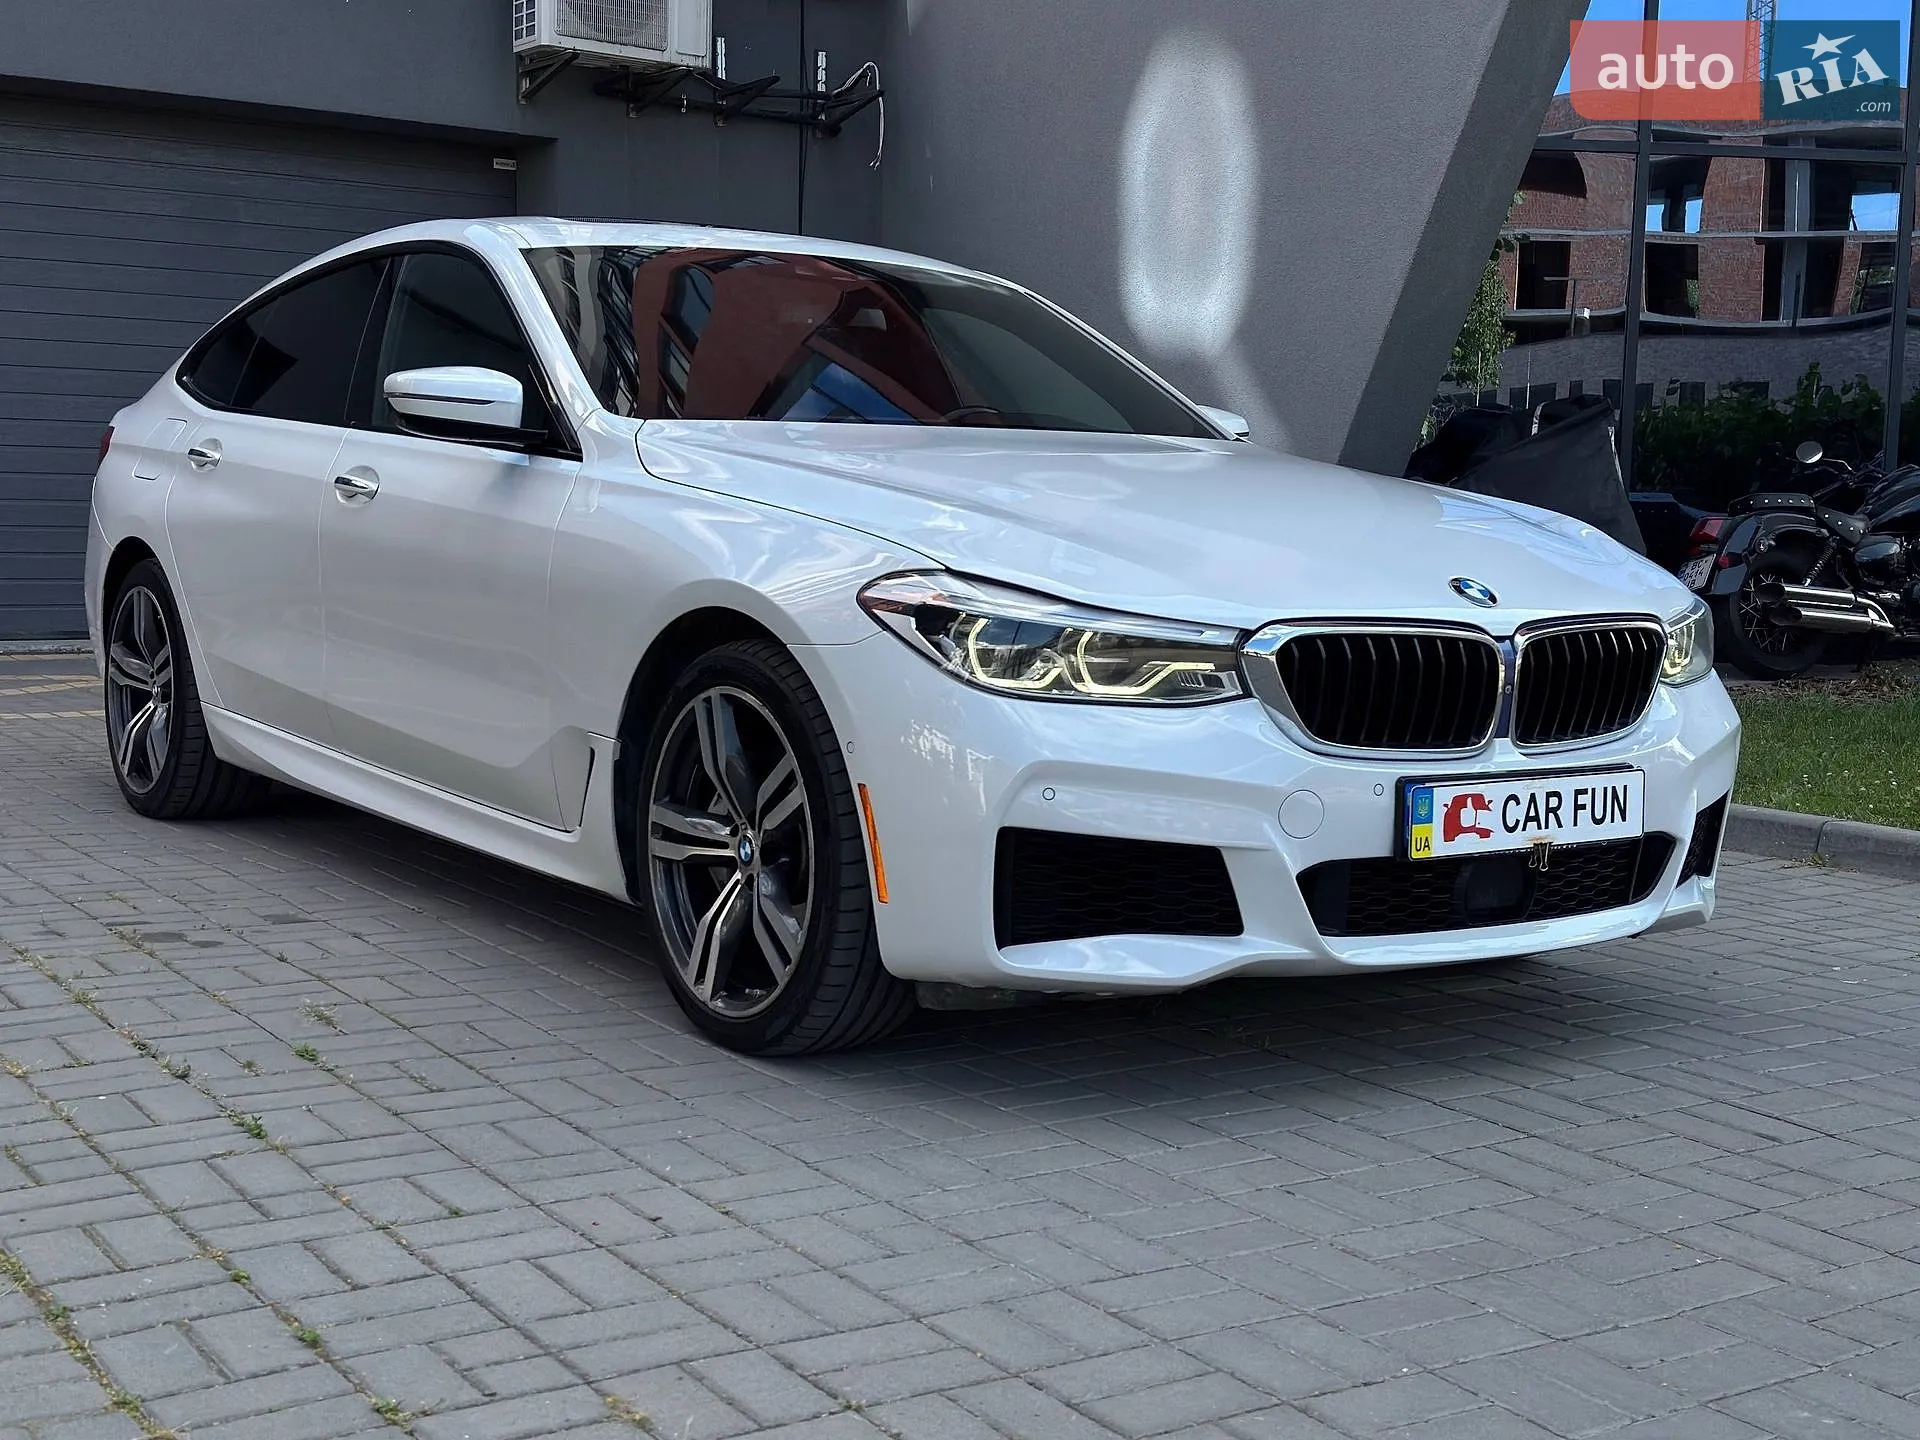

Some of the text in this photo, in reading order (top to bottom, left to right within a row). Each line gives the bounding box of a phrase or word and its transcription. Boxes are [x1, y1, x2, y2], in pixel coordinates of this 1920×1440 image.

[1502, 785, 1628, 834] CAR FUN
[1415, 837, 1431, 852] UA
